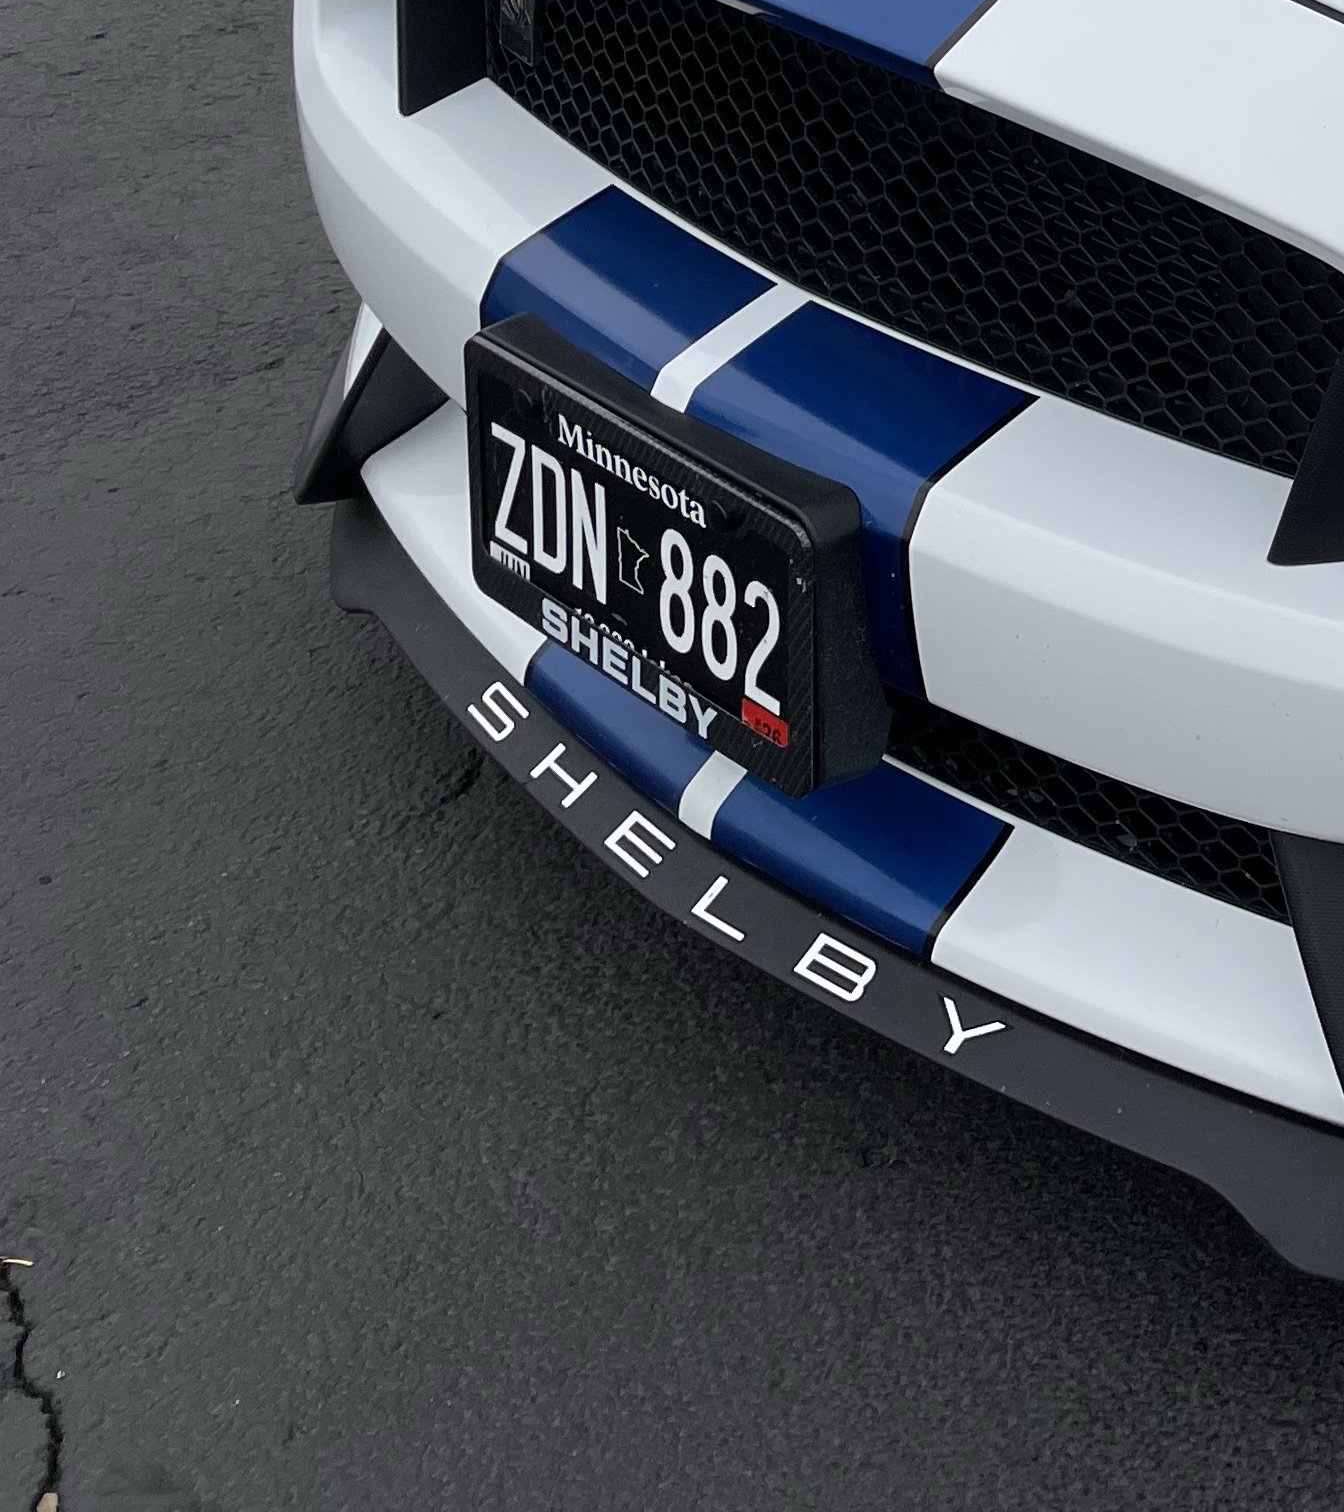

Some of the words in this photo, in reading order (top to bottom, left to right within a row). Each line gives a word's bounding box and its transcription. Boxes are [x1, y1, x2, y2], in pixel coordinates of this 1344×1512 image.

[491, 421, 607, 605] ZDN
[659, 528, 781, 716] 882
[556, 413, 707, 529] Minnesota
[541, 597, 718, 740] SHELBY
[467, 681, 1007, 1055] SHELBY
